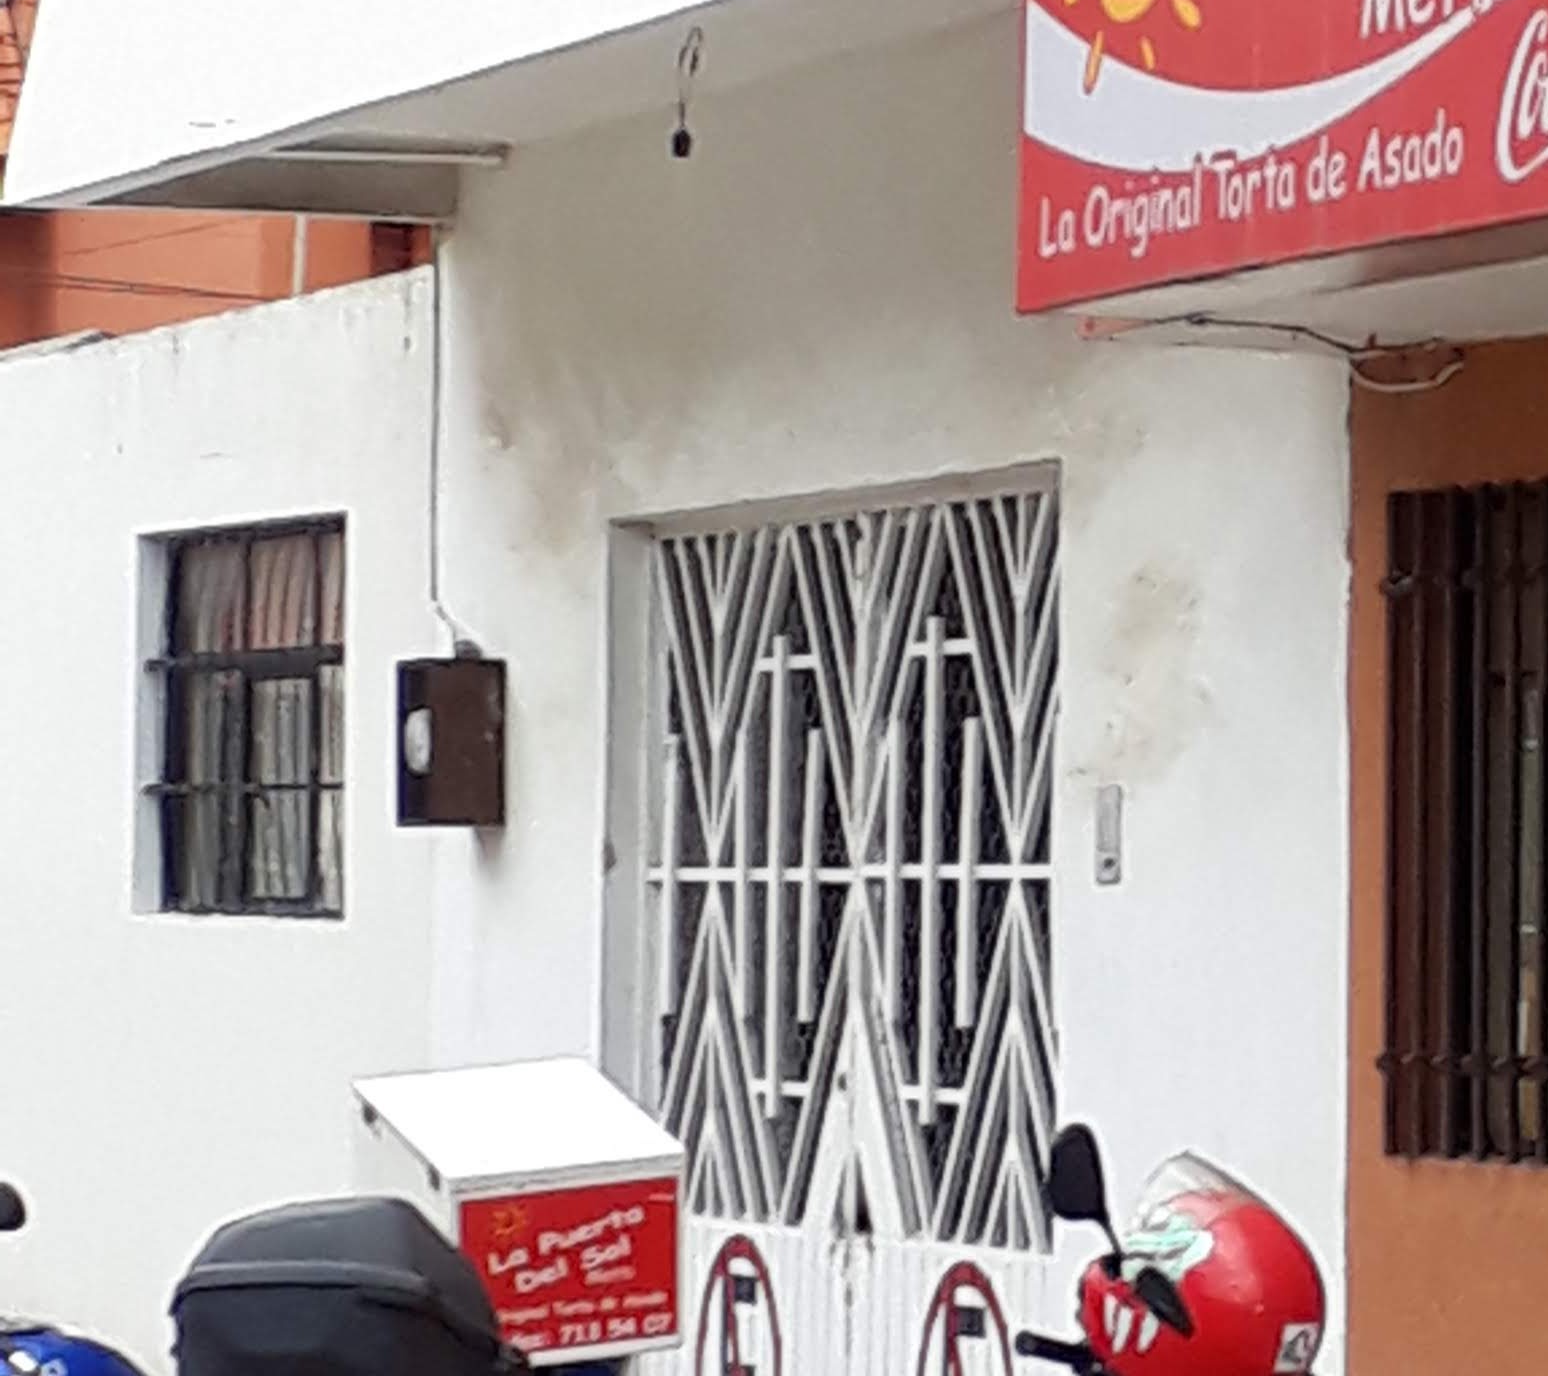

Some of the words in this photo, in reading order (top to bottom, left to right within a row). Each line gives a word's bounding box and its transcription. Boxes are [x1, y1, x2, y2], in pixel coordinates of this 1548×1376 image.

[1038, 196, 1076, 259] La
[1083, 156, 1202, 260] Original
[1208, 150, 1296, 221] Torta
[1306, 134, 1348, 203] de
[1358, 108, 1466, 192] Asado
